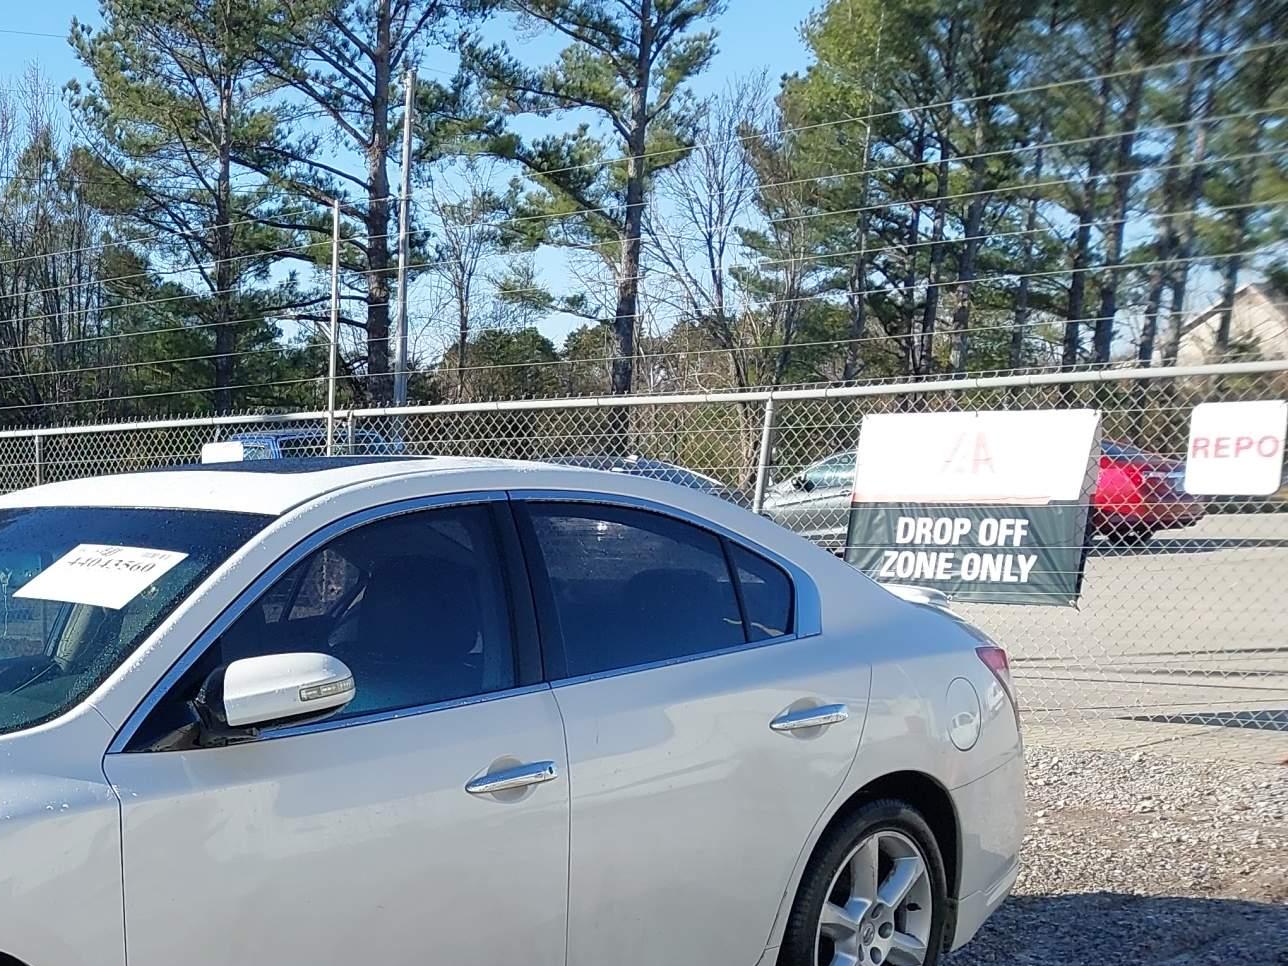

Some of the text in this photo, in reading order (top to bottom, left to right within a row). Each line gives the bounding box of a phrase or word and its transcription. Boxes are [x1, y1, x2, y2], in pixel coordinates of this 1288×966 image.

[1191, 435, 1280, 459] REPO
[896, 517, 1029, 547] DROP OFF
[879, 551, 1038, 582] ZONE ONLY
